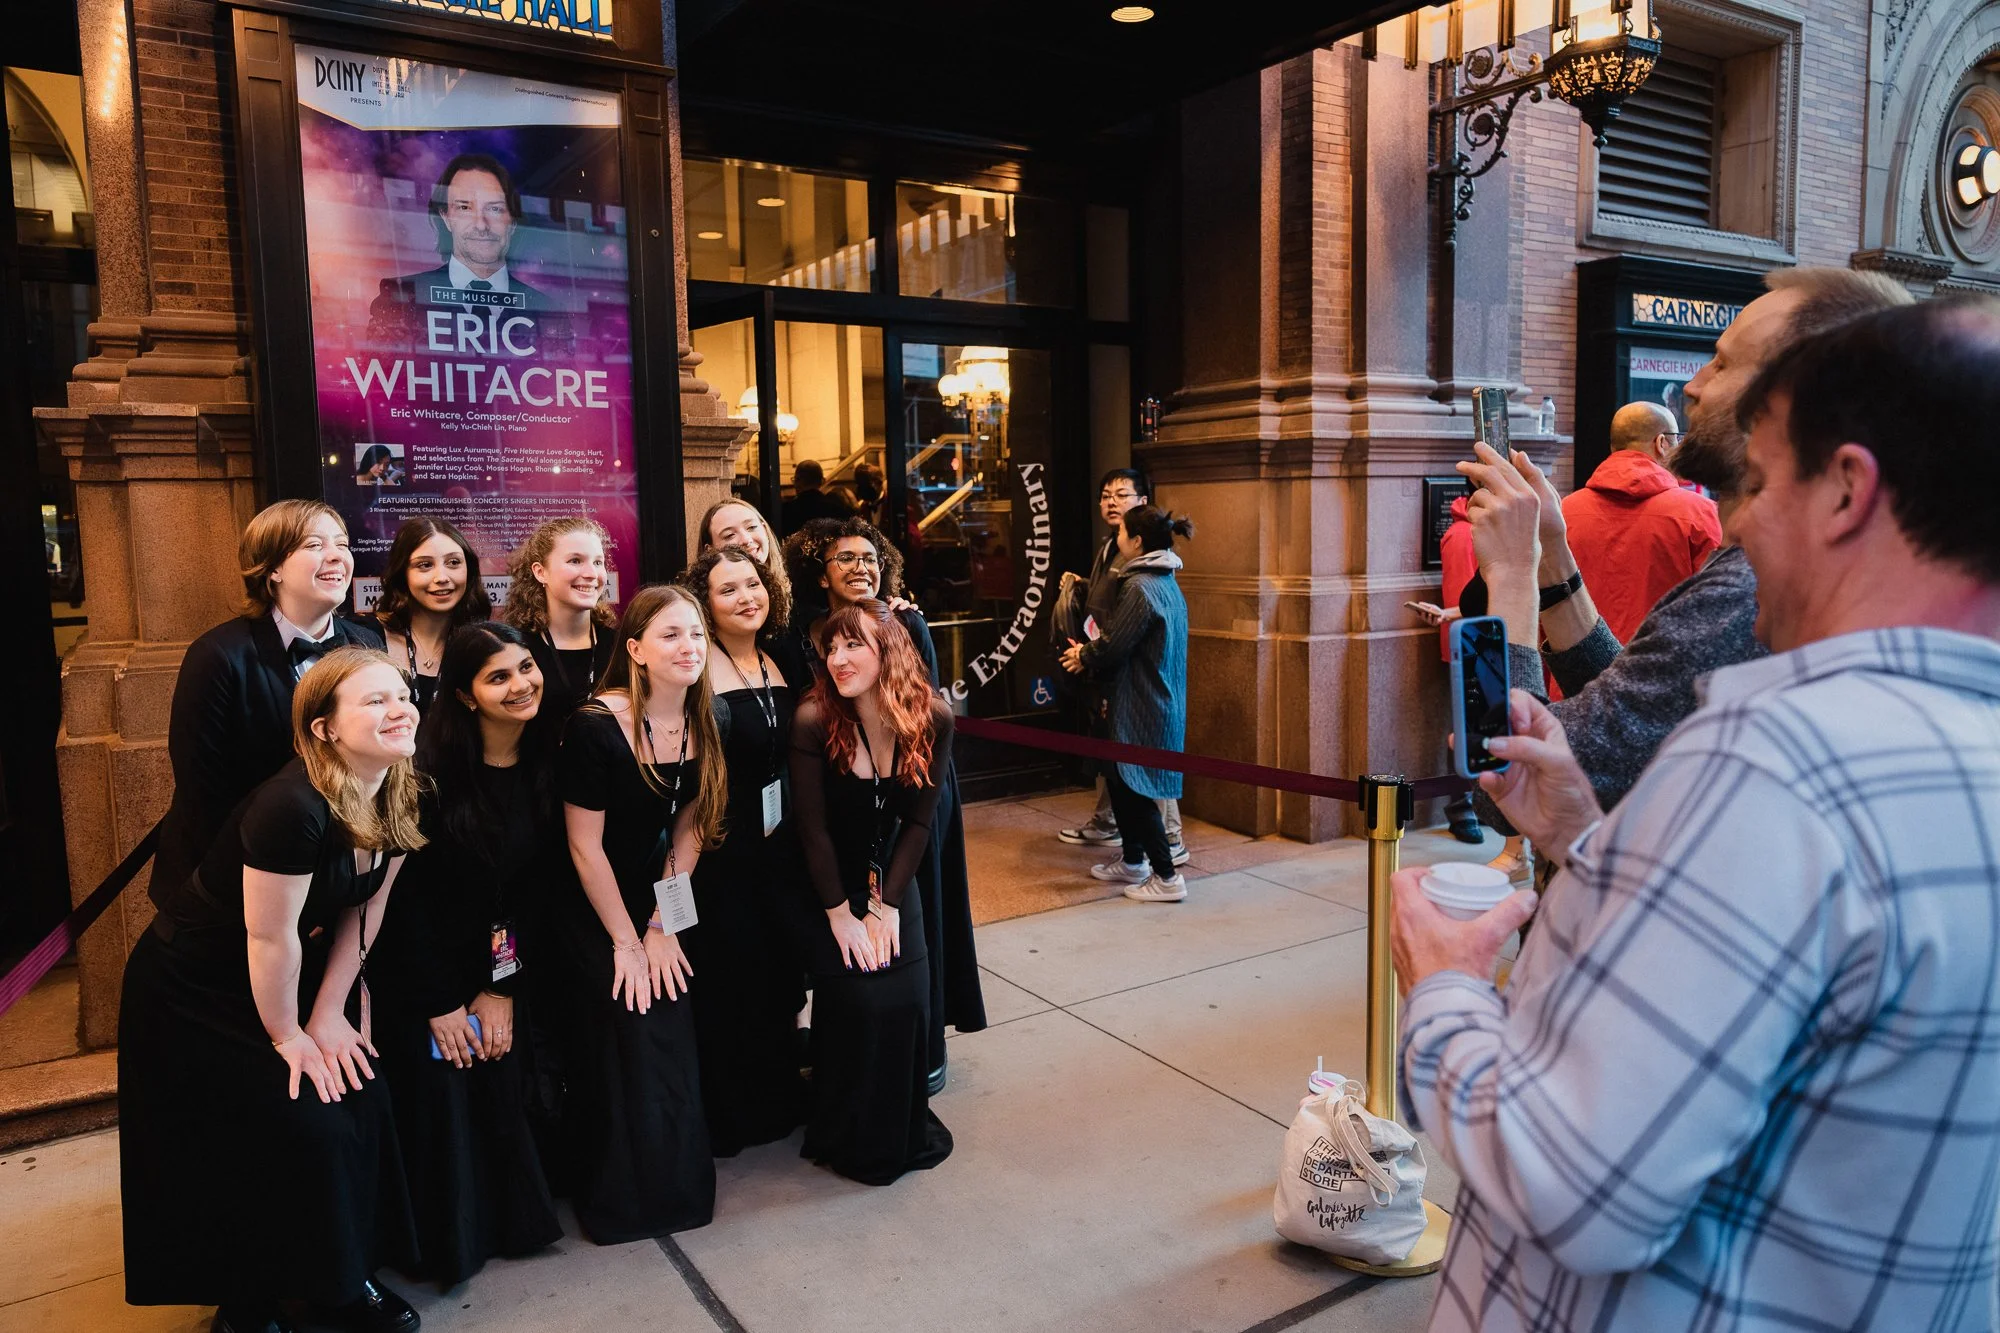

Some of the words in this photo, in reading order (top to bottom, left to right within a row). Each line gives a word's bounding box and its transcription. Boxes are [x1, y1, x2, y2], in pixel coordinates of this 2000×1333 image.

[515, 0, 612, 34] HALL
[314, 56, 366, 93] DCINY
[350, 97, 382, 106] PRESENTS
[436, 290, 456, 300] THE
[462, 292, 498, 303] MUSIC
[503, 296, 518, 305] OF
[427, 310, 537, 357] ERIC
[1630, 357, 1679, 373] CARNEGIE
[345, 357, 609, 409] WHITACRE
[390, 408, 411, 418] Eric
[413, 409, 464, 421] Whitacre,
[466, 411, 572, 424] Composer/Conductor
[440, 422, 459, 431] Kelly
[461, 423, 493, 431] Yu-Chieh
[494, 424, 507, 432] Lin,
[412, 445, 447, 454] Featuring
[464, 446, 502, 455] Aurumque,
[519, 447, 545, 455] Hebrew
[564, 449, 586, 457] Songs,
[587, 449, 604, 457] Hurt,
[429, 454, 466, 462] selections
[487, 455, 500, 463] The
[526, 456, 539, 464] Veil
[540, 456, 572, 466] alongside
[573, 458, 593, 466] works
[594, 458, 604, 466] by
[413, 463, 443, 471] Jennifer
[445, 464, 462, 473] Lucy
[463, 464, 485, 472] Cook,
[486, 464, 509, 472] Moses
[510, 465, 534, 474] Hogan,
[535, 466, 561, 474] Rhon
[414, 472, 428, 480] and
[430, 472, 446, 480] Sara
[448, 473, 480, 482] Hopkins.
[967, 462, 1050, 688] Extraordinary
[1305, 1155, 1359, 1179] DEPARTM
[1302, 1167, 1340, 1188] STORE
